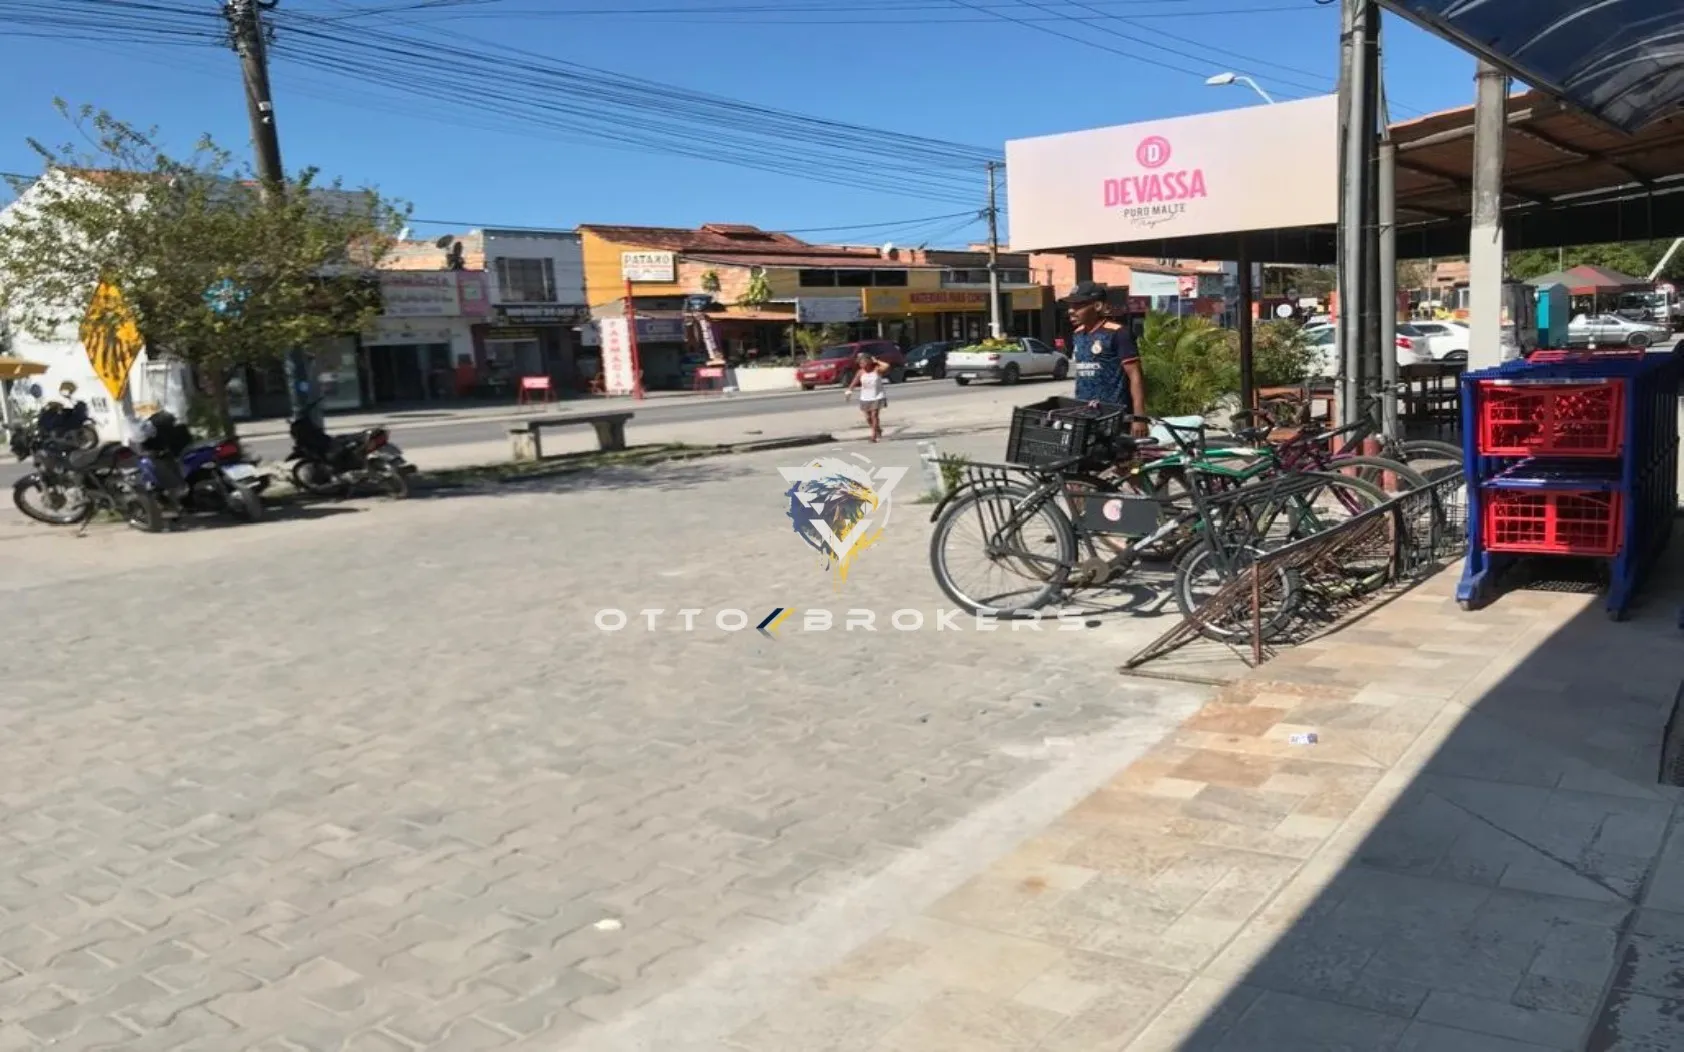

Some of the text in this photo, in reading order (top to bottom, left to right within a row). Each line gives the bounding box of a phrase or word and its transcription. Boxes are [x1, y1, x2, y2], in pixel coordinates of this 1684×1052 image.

[1104, 168, 1208, 208] DEVASSA
[1124, 203, 1186, 219] PURO MALTE
